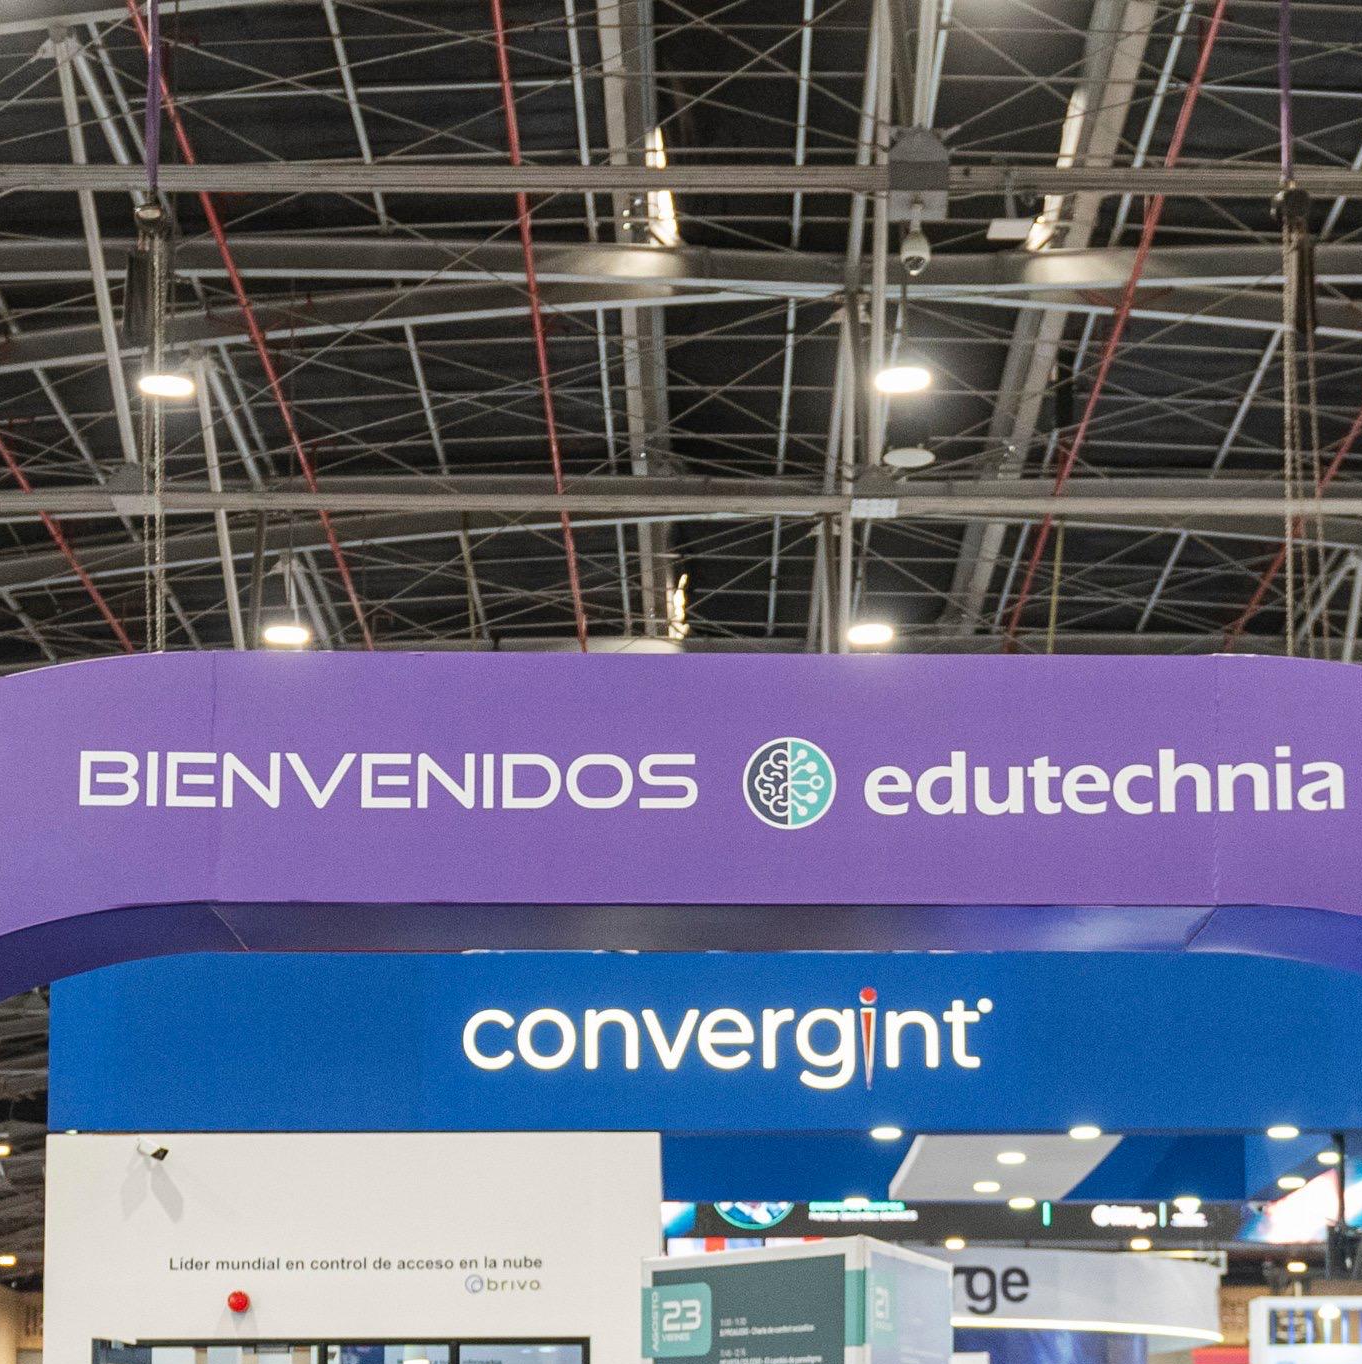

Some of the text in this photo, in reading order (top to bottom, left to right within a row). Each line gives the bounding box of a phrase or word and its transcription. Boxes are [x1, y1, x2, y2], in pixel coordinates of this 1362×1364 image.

[79, 747, 1346, 815] BIENVENIDOS edutechnia
[462, 986, 985, 1090] convergint
[216, 1256, 280, 1270] mundial
[286, 1259, 304, 1270] en
[310, 1256, 367, 1270] control
[373, 1257, 391, 1270] de
[397, 1258, 454, 1270] acceso
[459, 1258, 478, 1269] en
[484, 1255, 497, 1269] la
[503, 1255, 543, 1269] nube
[486, 1278, 541, 1291] brivo
[662, 1299, 701, 1332] 23
